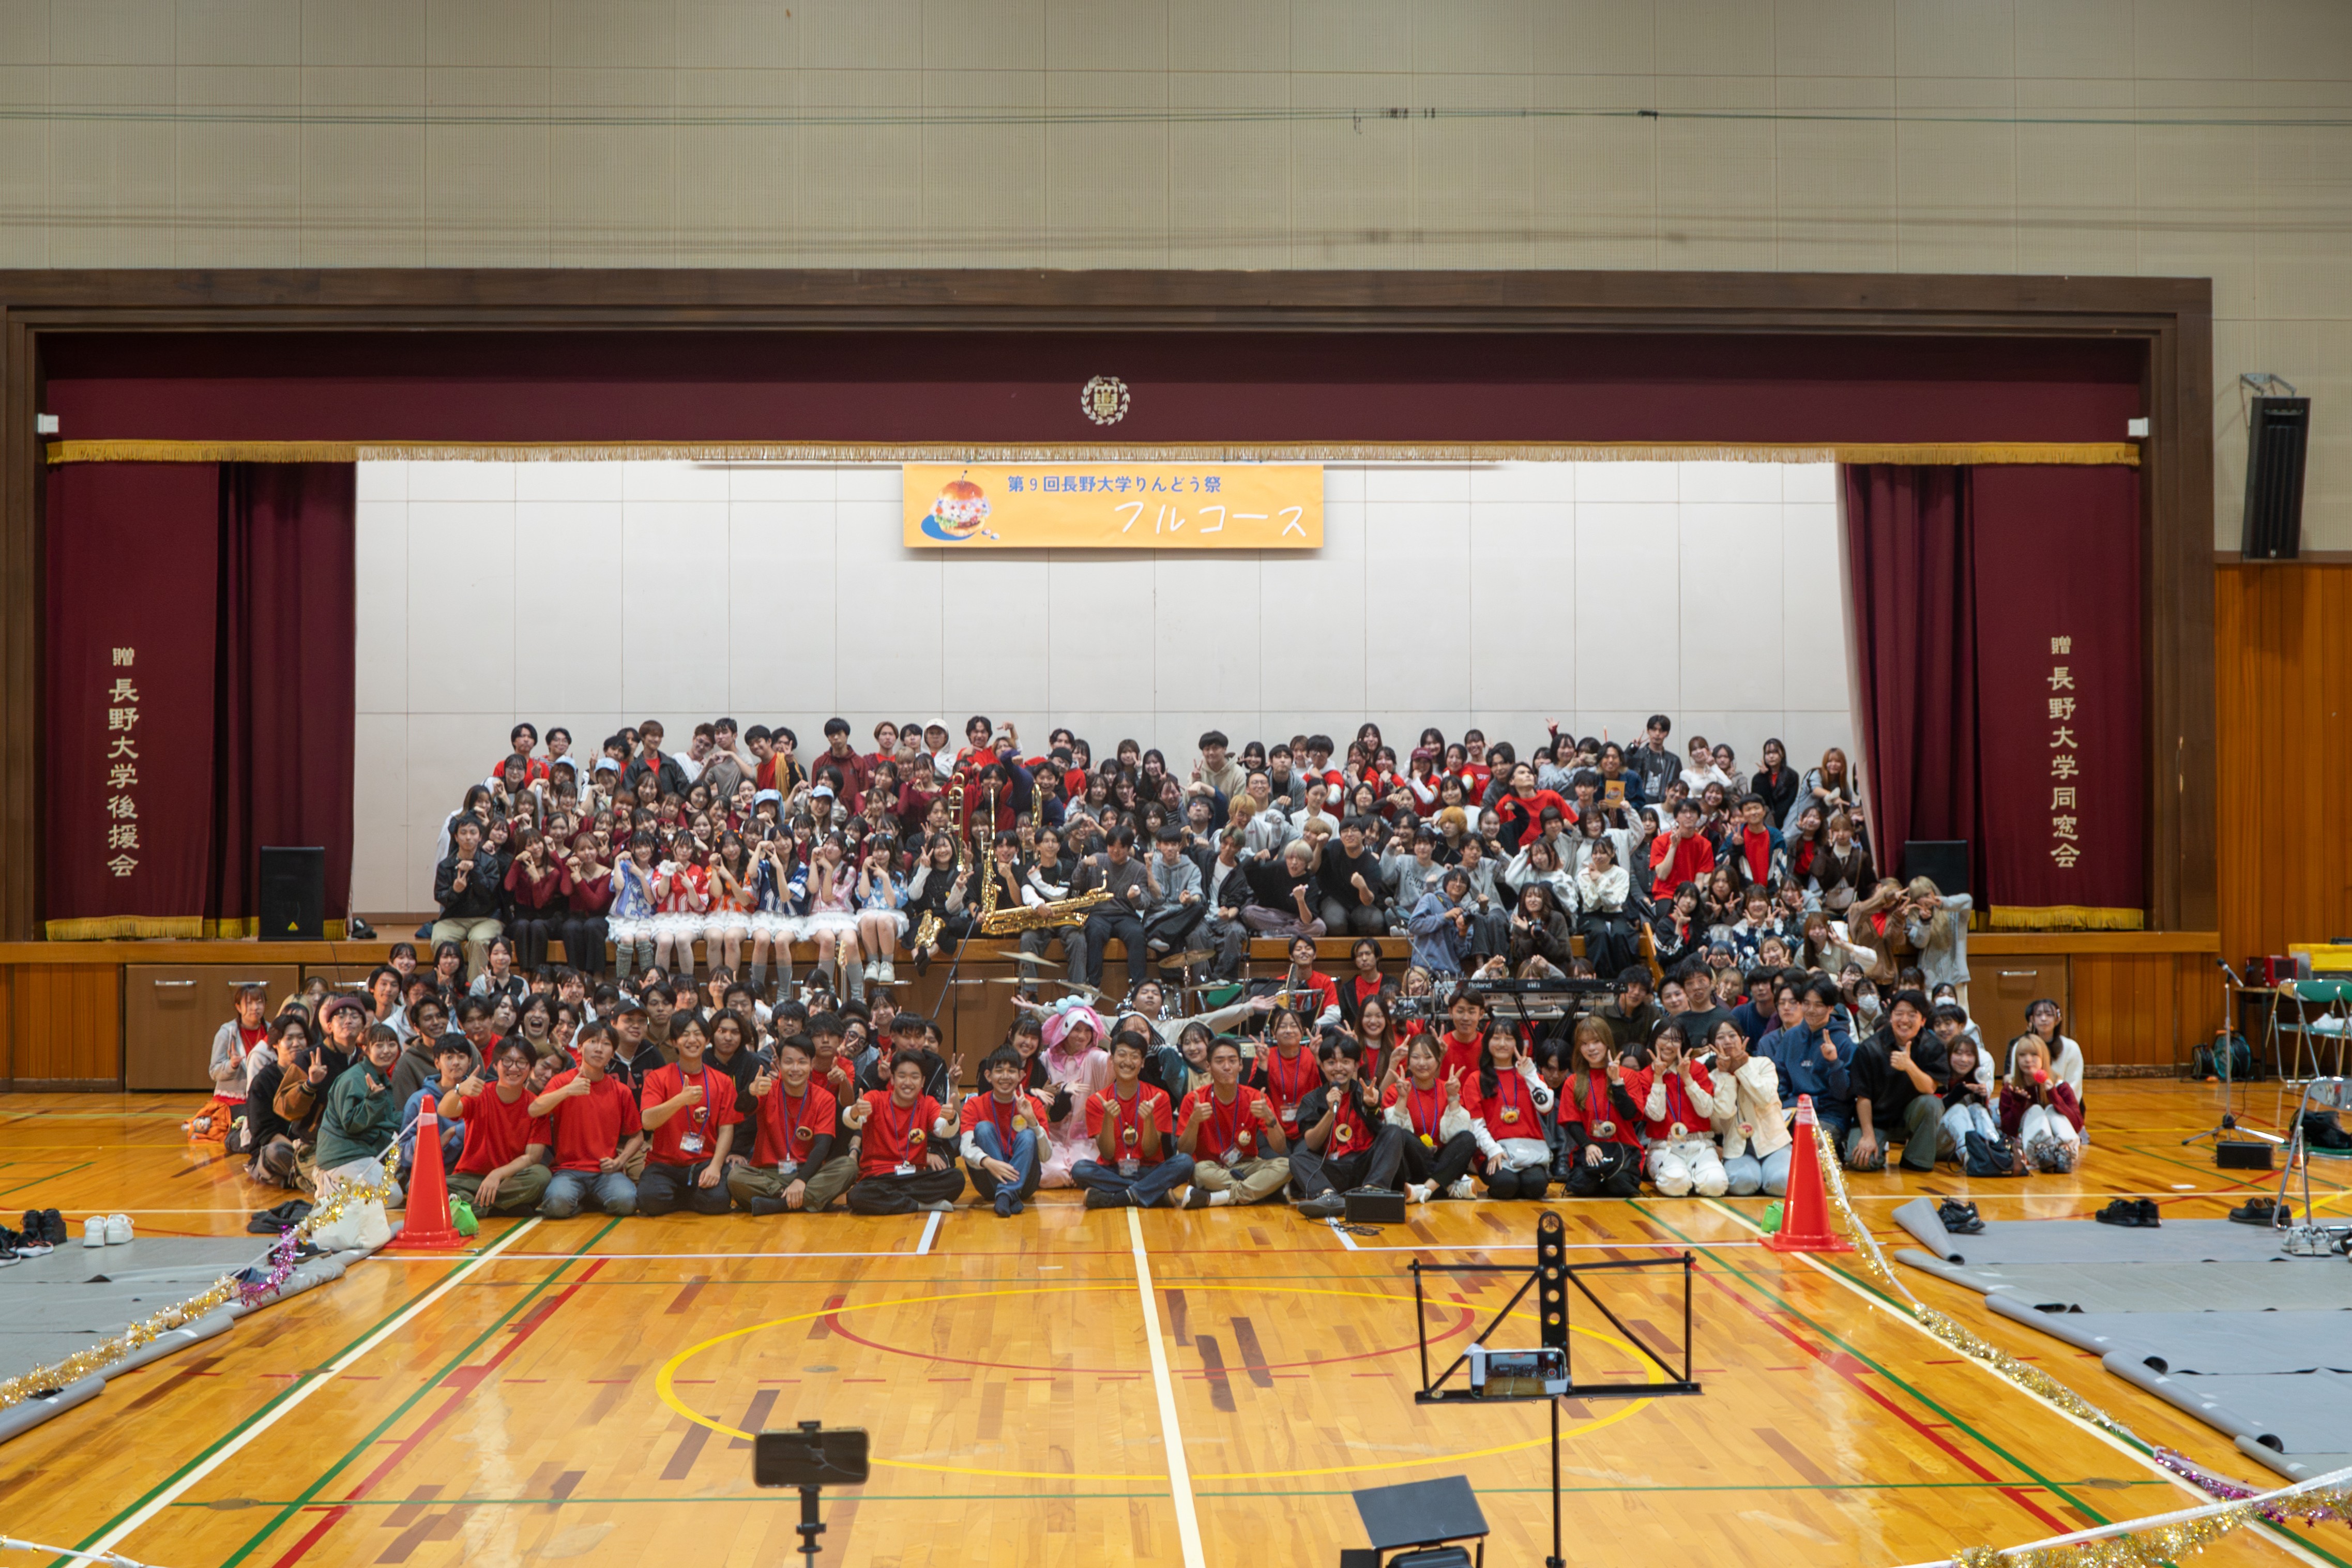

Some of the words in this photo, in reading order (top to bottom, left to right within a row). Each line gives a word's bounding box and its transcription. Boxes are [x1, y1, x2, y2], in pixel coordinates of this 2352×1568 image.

[1008, 476, 1221, 493] 第9回長野大学りんどう祭
[1114, 501, 1306, 538] フルコース
[112, 647, 135, 666] 贈
[2051, 635, 2071, 654] 贈
[107, 678, 140, 877] 長野大学後援会
[2047, 666, 2081, 868] 長野大学同窓会
